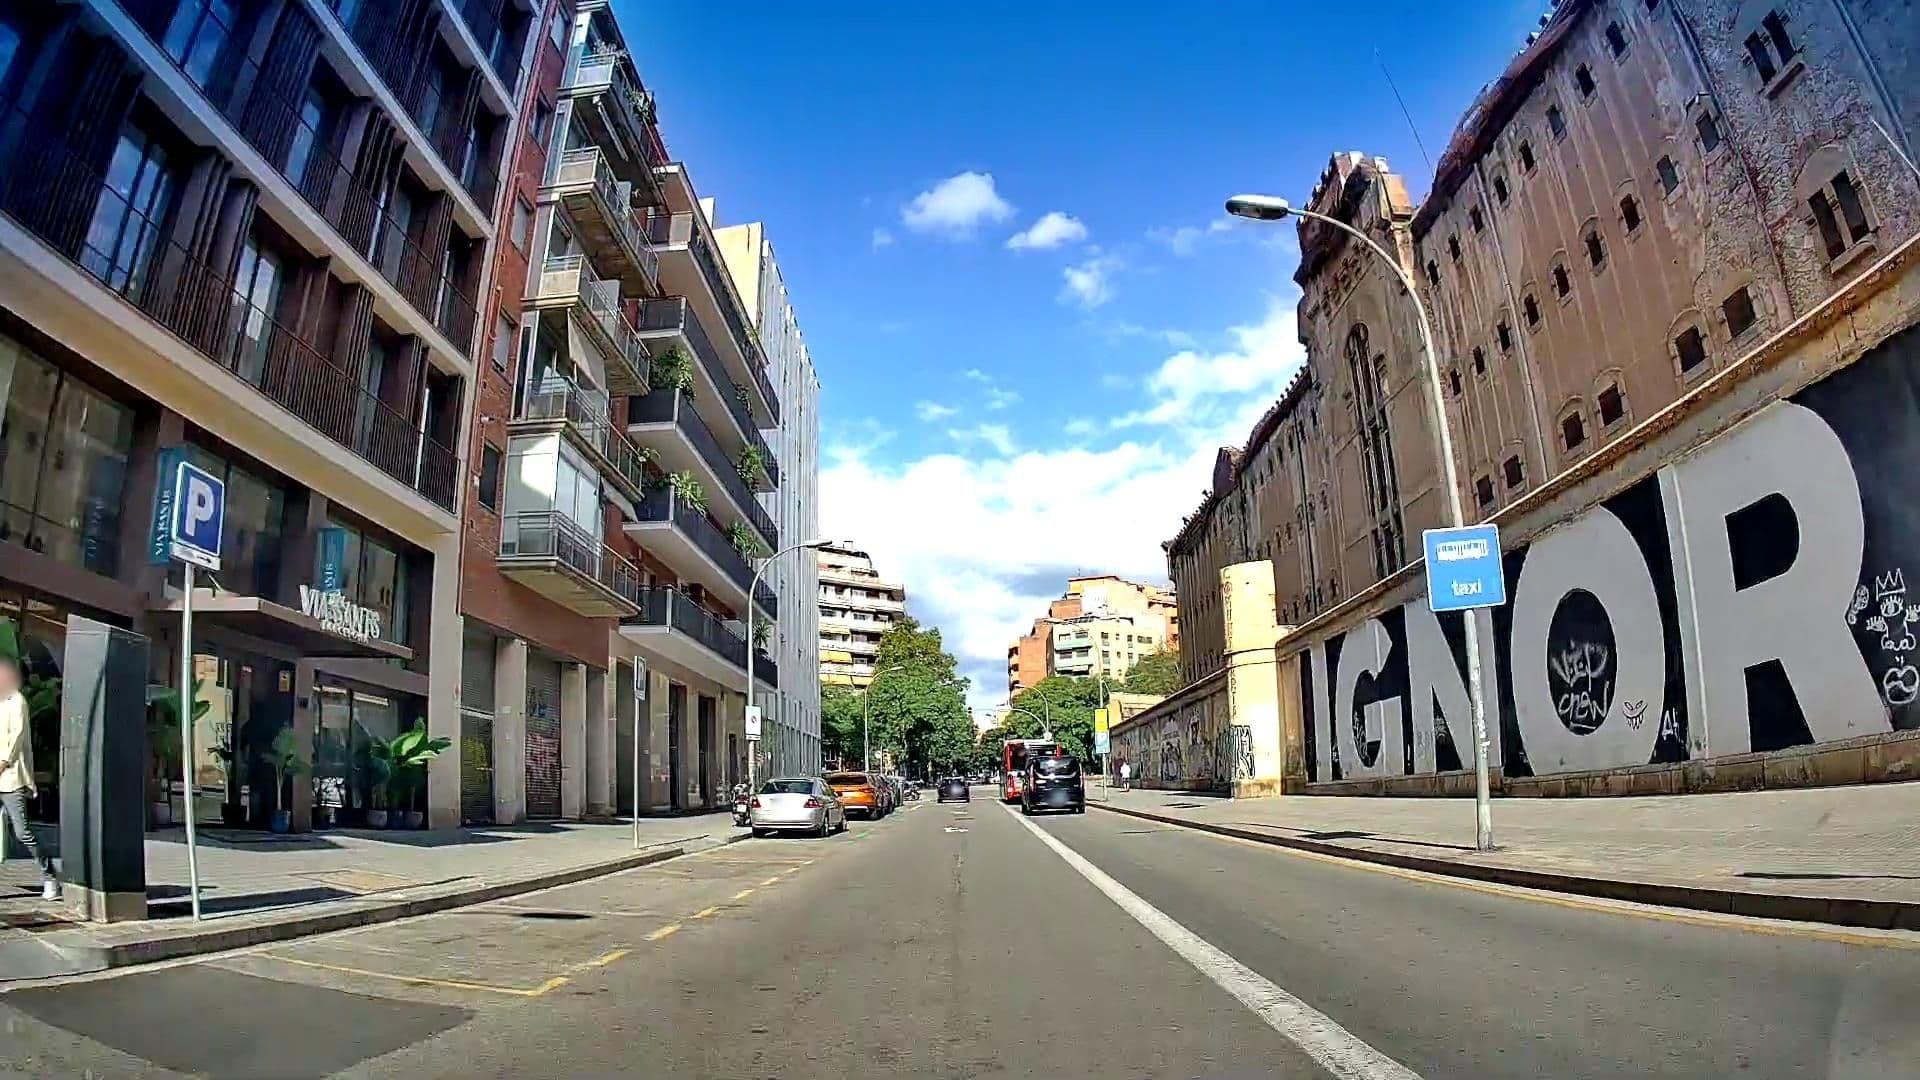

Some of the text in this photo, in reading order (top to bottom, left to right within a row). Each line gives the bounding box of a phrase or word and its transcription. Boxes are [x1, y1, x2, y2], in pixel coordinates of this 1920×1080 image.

[185, 476, 214, 537] P
[1310, 400, 1893, 783] IGNOR
[1452, 578, 1482, 596] taxi
